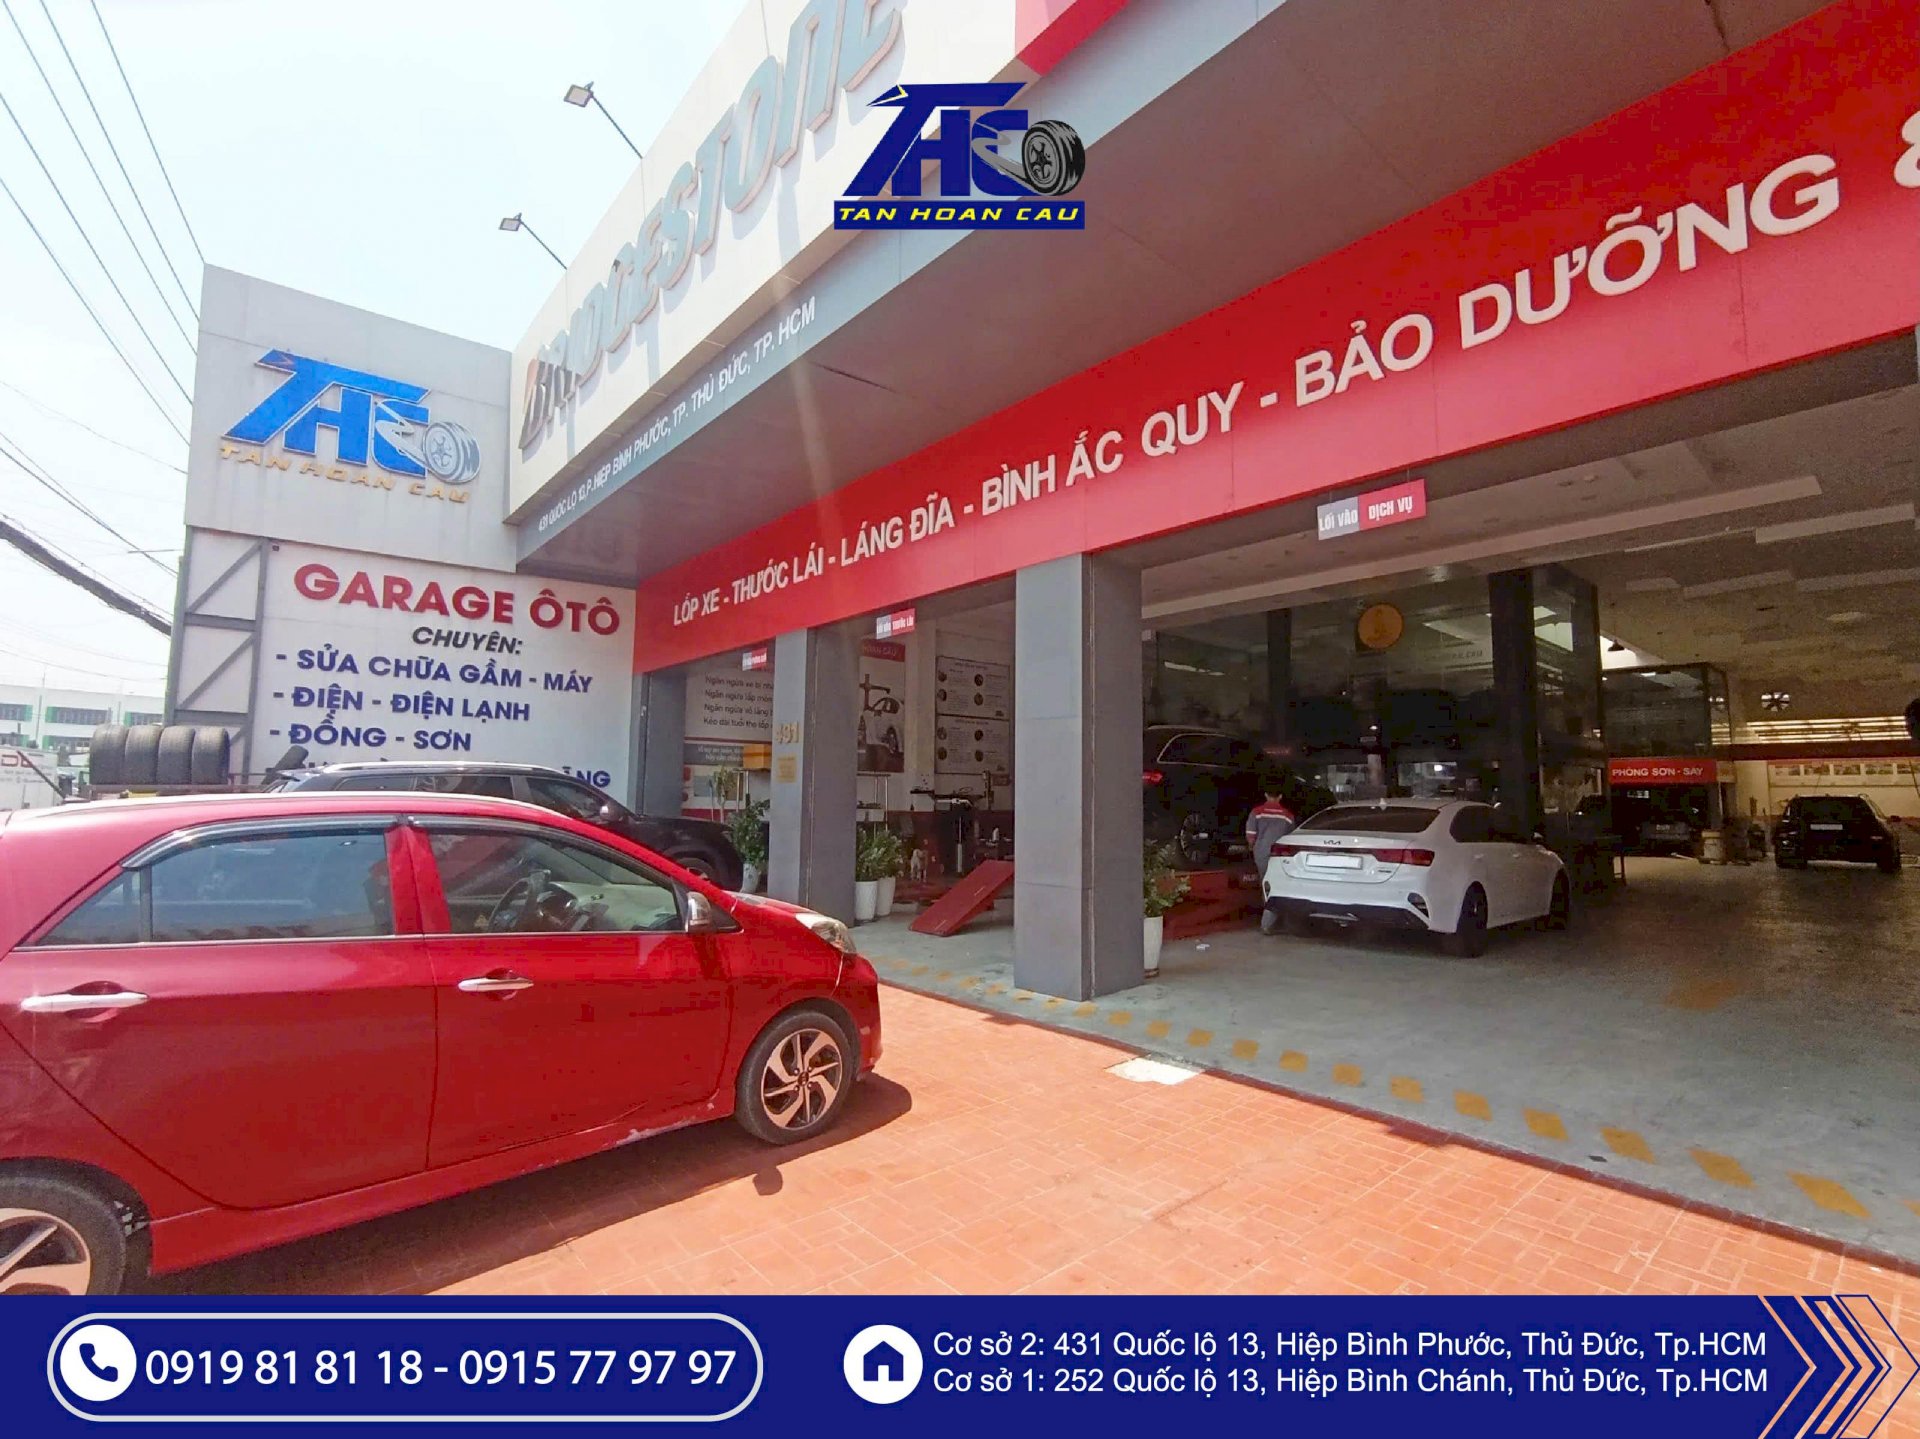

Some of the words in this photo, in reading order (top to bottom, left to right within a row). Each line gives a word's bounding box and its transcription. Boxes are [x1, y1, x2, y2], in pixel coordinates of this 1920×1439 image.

[612, 446, 632, 476] BÌNH
[633, 416, 671, 459] PHƯỚC,
[673, 401, 689, 427] TP.
[691, 373, 714, 412] THỦ
[719, 350, 751, 393] ĐỨC,
[754, 331, 774, 363] TP.
[778, 296, 816, 346] HCM
[701, 587, 721, 617] XE
[732, 558, 789, 606] THƯỚC
[792, 542, 825, 584] LÁI
[840, 520, 904, 567] LÁNG
[909, 491, 955, 542] ĐĨA
[981, 454, 1057, 517] BÌNH
[1064, 428, 1125, 487] ẮC
[1140, 381, 1245, 458] QUY
[1294, 313, 1433, 408] BẢO
[1458, 153, 1841, 351] DƯỠNG
[220, 445, 290, 471] TAN
[299, 461, 396, 491] HOAN
[407, 482, 471, 503] CAU
[1319, 511, 1335, 531] LỐI
[1337, 508, 1358, 528] VÀO
[1368, 499, 1394, 522] DỊCH
[1396, 496, 1413, 513] VỤ
[293, 563, 514, 624] GARAGE
[529, 588, 620, 636] ÔTÔ
[412, 626, 523, 655] CHUYÊN:
[297, 644, 359, 676] SỬA
[368, 655, 452, 682] CHỮA
[459, 658, 522, 687] GẦM
[543, 668, 593, 693] MÁY
[292, 683, 363, 714] ĐIỆN
[390, 690, 454, 720] ĐIỆN
[461, 700, 530, 724] LẠNH
[288, 713, 387, 747] ĐỒNG
[413, 728, 471, 751] SƠN
[1652, 767, 1676, 776] SƠN
